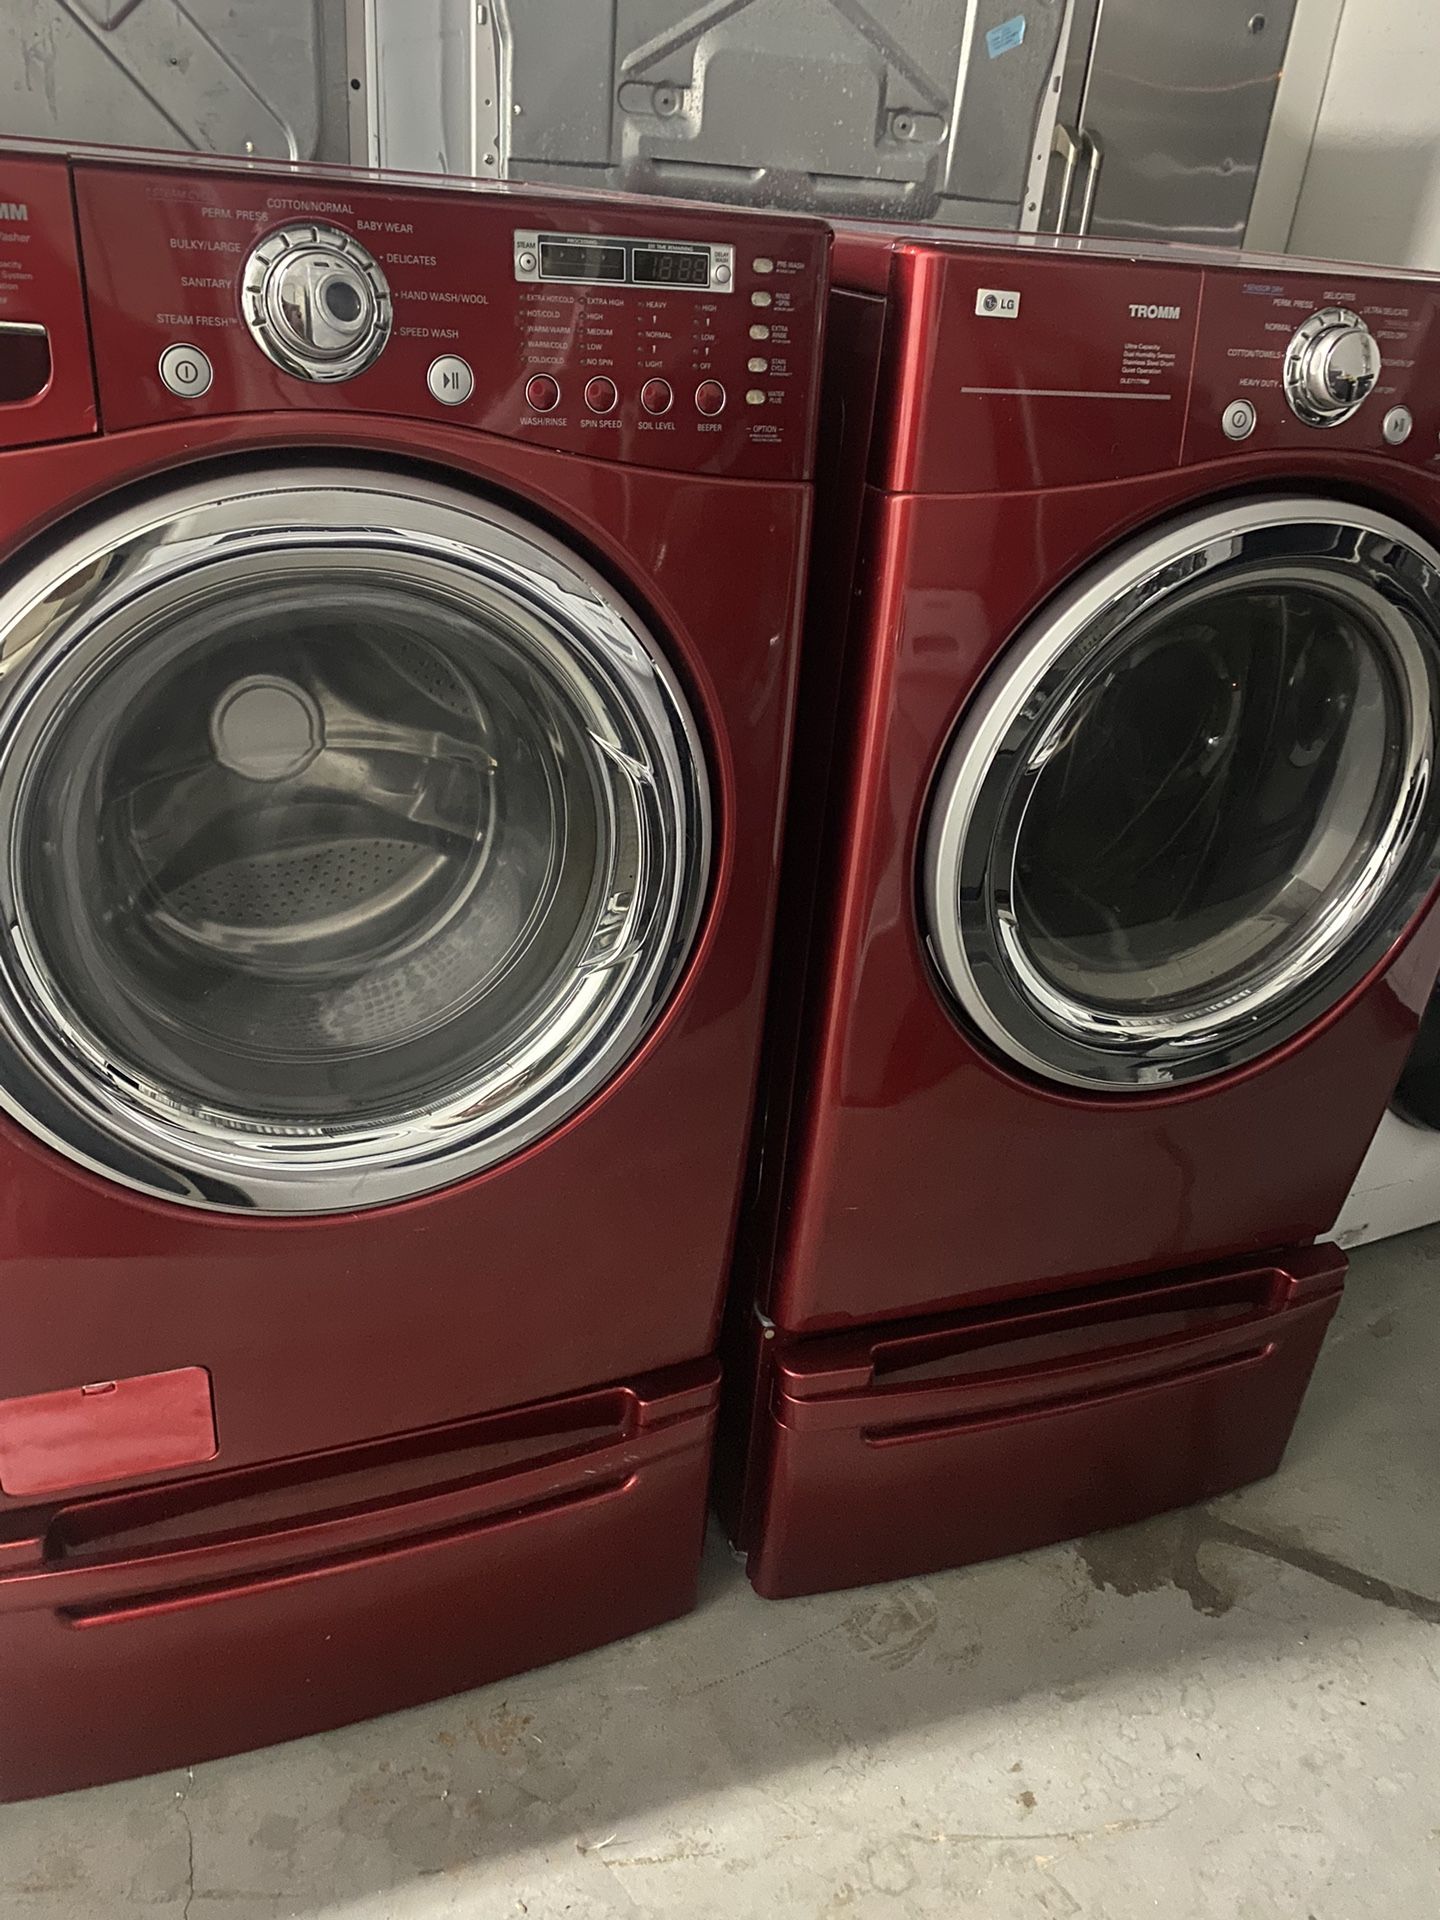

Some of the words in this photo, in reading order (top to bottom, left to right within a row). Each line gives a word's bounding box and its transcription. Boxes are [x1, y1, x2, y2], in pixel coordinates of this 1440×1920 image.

[266, 198, 354, 214] COTTON/NORMAL
[356, 219, 383, 231] BABY
[384, 222, 413, 234] WEAR
[169, 238, 241, 253] BULKY/LARGE
[517, 241, 536, 249] STEAM
[386, 253, 437, 266] DELICATES
[180, 276, 232, 289] SANITARY
[400, 290, 428, 301] HAND
[429, 291, 489, 305] WASH/WOOL
[586, 297, 608, 305] EXTRA
[608, 299, 625, 307] HIGH
[645, 301, 667, 309] HEAVY
[1000, 298, 1015, 310] LG
[586, 312, 604, 321] HIGH
[1129, 304, 1180, 319] TROMM
[156, 313, 194, 325] STEAM
[399, 326, 429, 337] SPEED
[430, 328, 459, 339] WASH
[586, 328, 613, 336] MEDIUM
[645, 331, 672, 339] NORMAL
[586, 343, 603, 351] LOW
[586, 358, 598, 366] NO
[598, 358, 614, 367] SPIN
[645, 360, 663, 369] LIGHT
[1239, 378, 1260, 388] HEAVY
[1260, 379, 1280, 388] DUTY
[520, 417, 568, 427] WASH/RINSE
[580, 419, 598, 429] SPIN
[598, 420, 623, 430] SPEED
[637, 421, 654, 431] SOIL
[655, 422, 676, 432] LEVEL
[697, 423, 723, 433] BEEPER
[752, 424, 777, 433] OPTION
